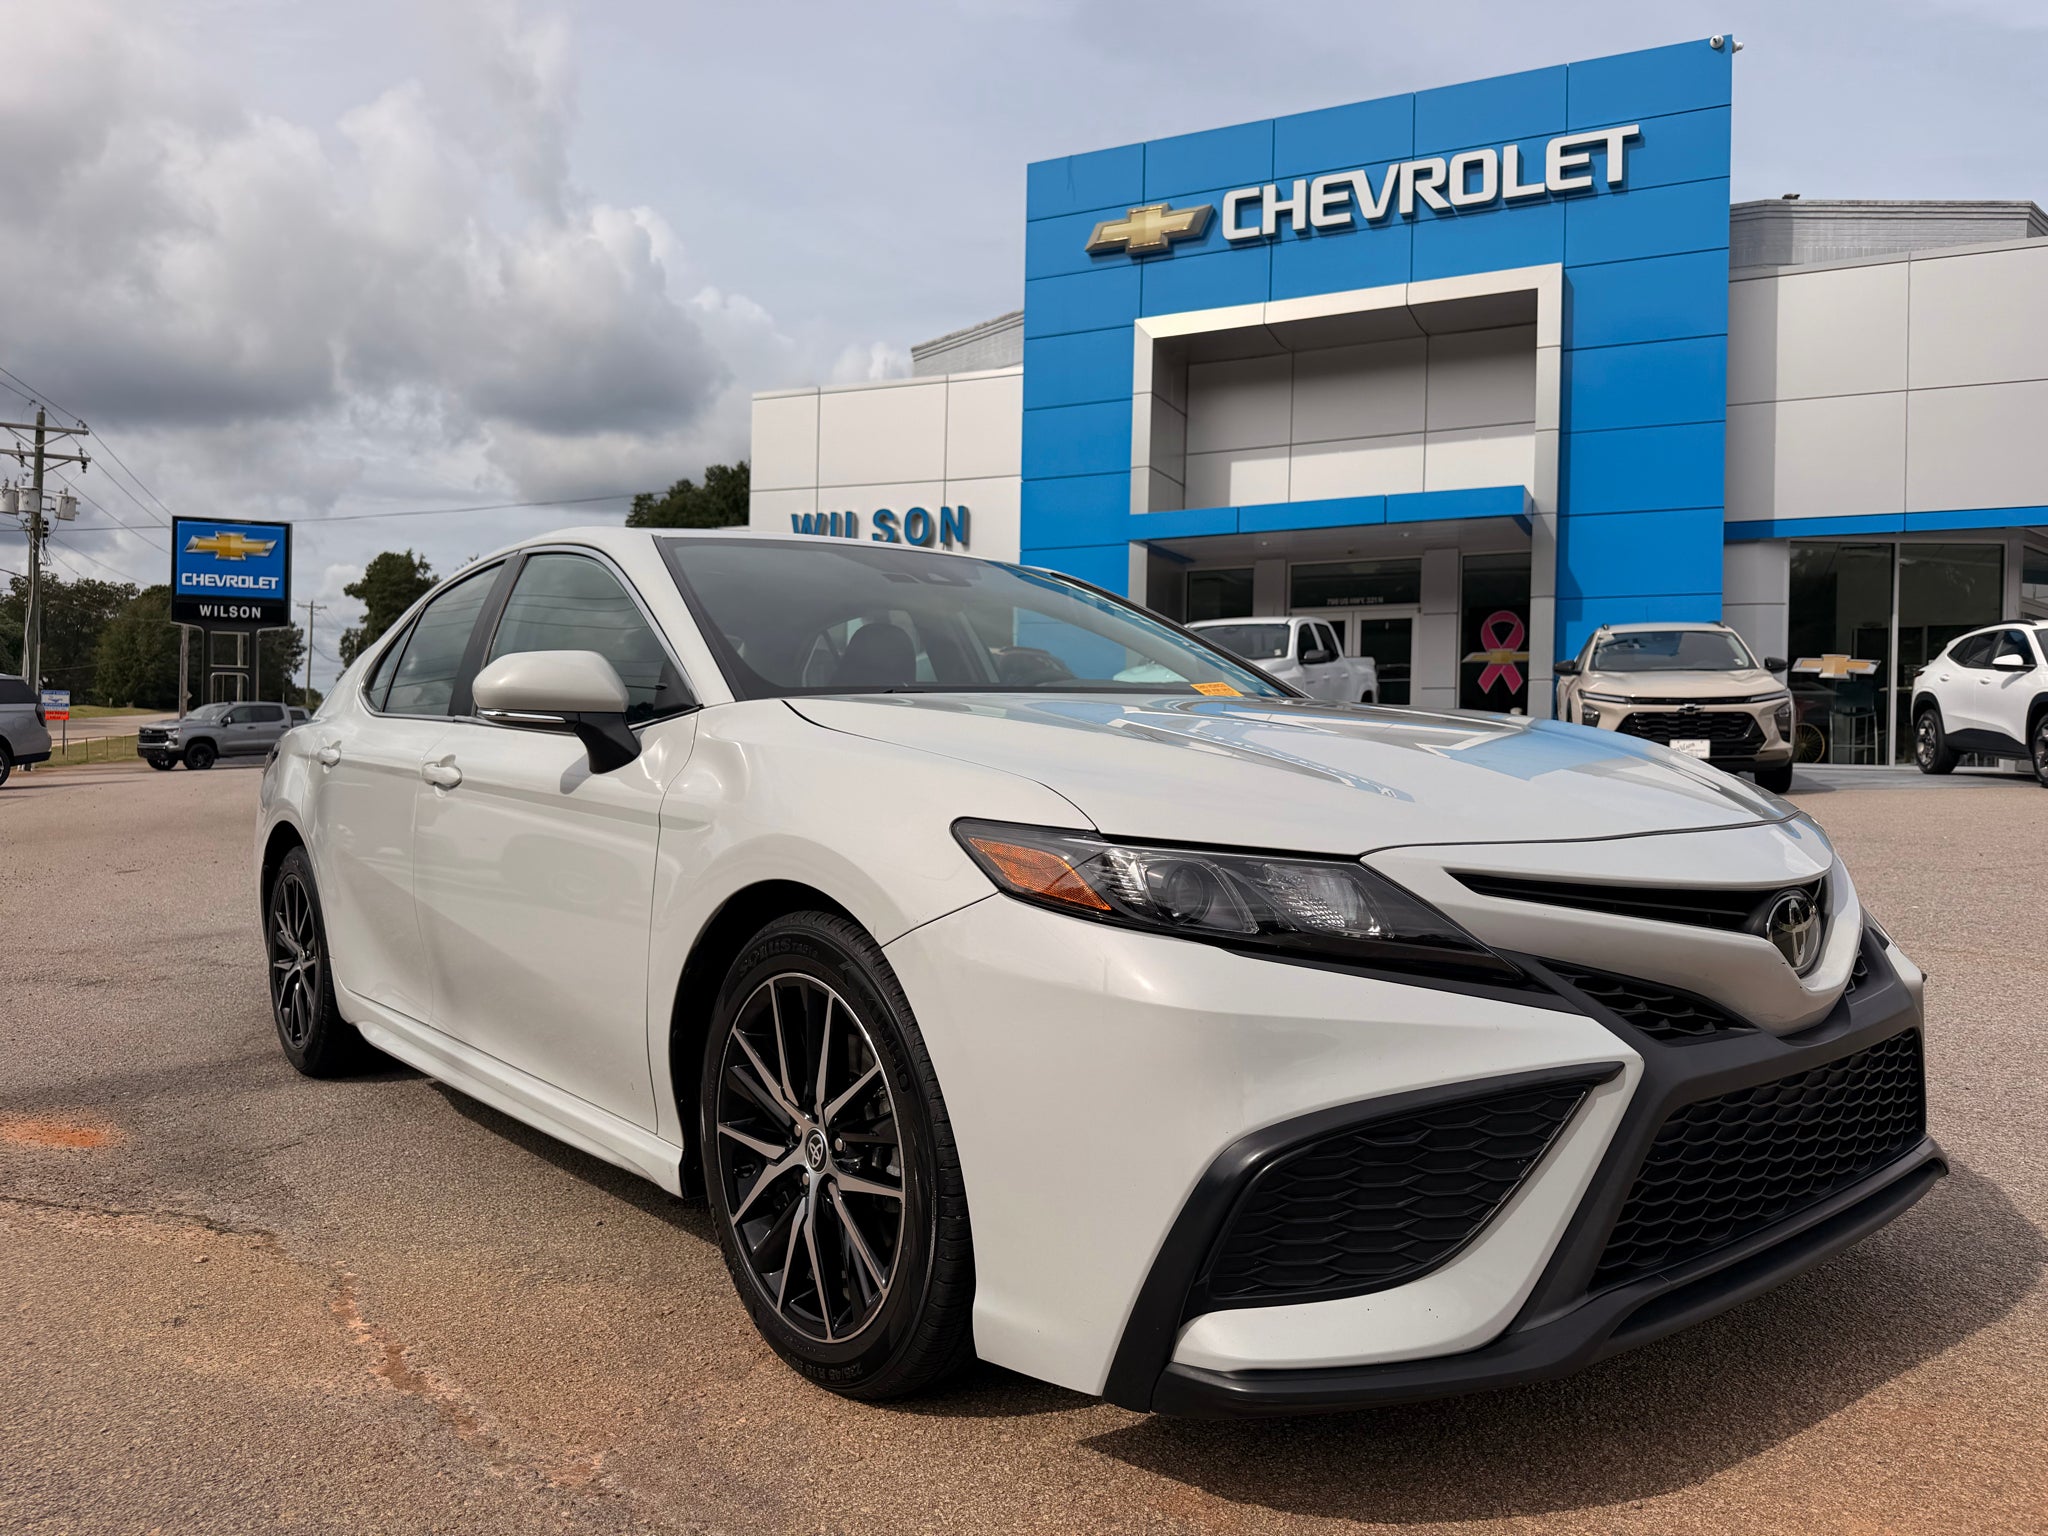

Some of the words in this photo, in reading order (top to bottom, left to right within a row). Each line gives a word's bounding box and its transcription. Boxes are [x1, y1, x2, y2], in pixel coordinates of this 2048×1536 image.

[1222, 123, 1640, 242] CHEVROLET
[181, 572, 279, 590] CHEVROLET
[199, 604, 262, 619] WILSON
